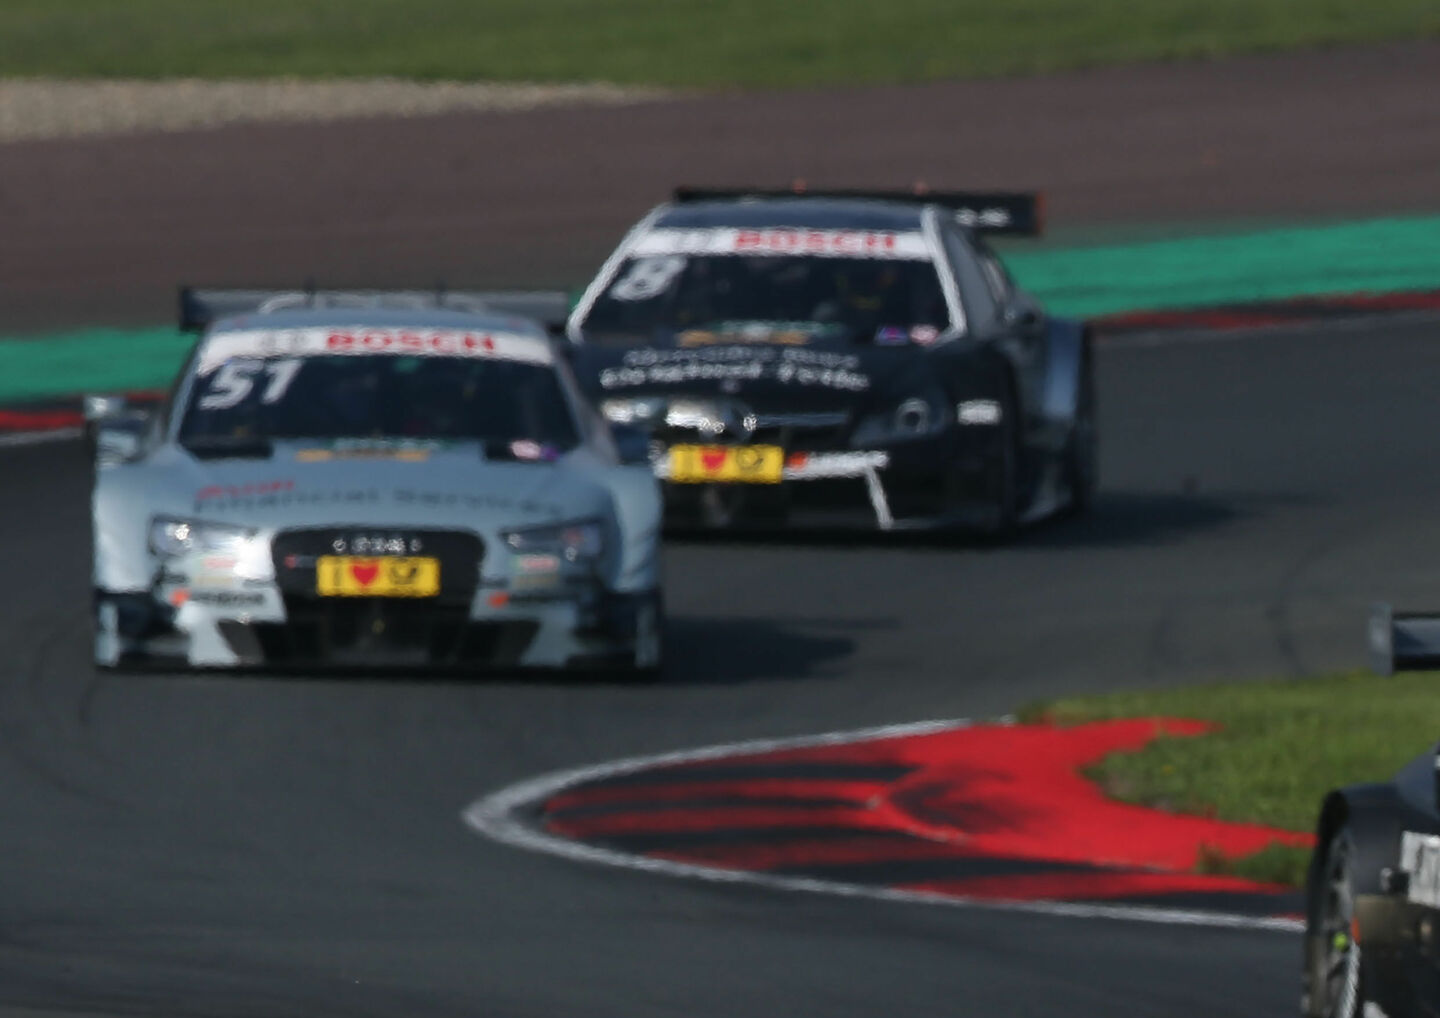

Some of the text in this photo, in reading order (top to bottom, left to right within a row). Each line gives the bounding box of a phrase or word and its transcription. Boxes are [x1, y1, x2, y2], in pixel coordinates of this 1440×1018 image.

[733, 230, 895, 250] BOSCH
[610, 257, 688, 300] 8
[326, 332, 496, 352] BOSCH
[200, 358, 304, 410] 51
